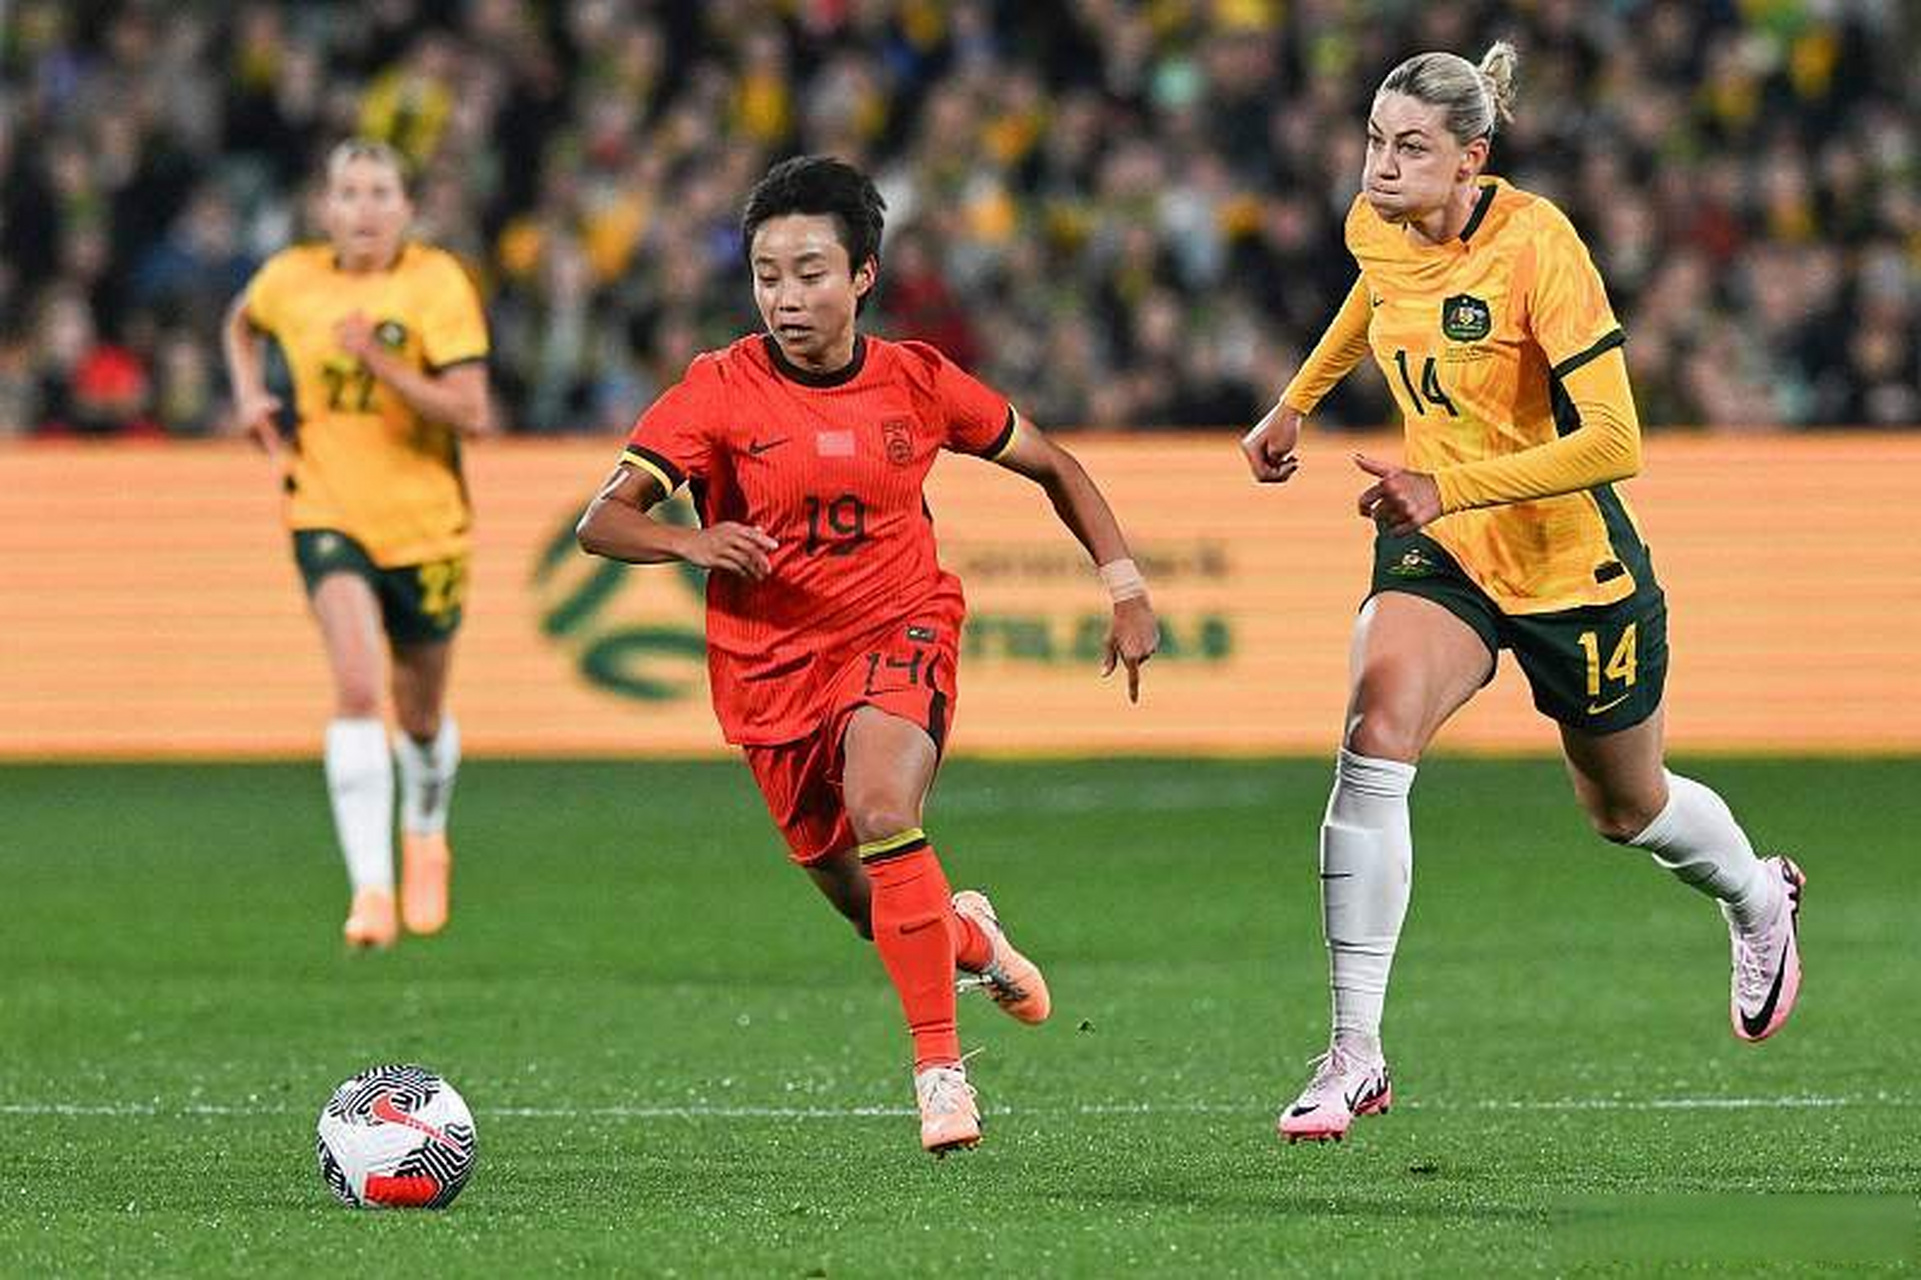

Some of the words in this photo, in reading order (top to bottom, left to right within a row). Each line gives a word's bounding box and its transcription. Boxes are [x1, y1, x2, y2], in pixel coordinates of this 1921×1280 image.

[1394, 349, 1459, 417] 14
[805, 495, 867, 557] 19
[1577, 621, 1638, 695] 14
